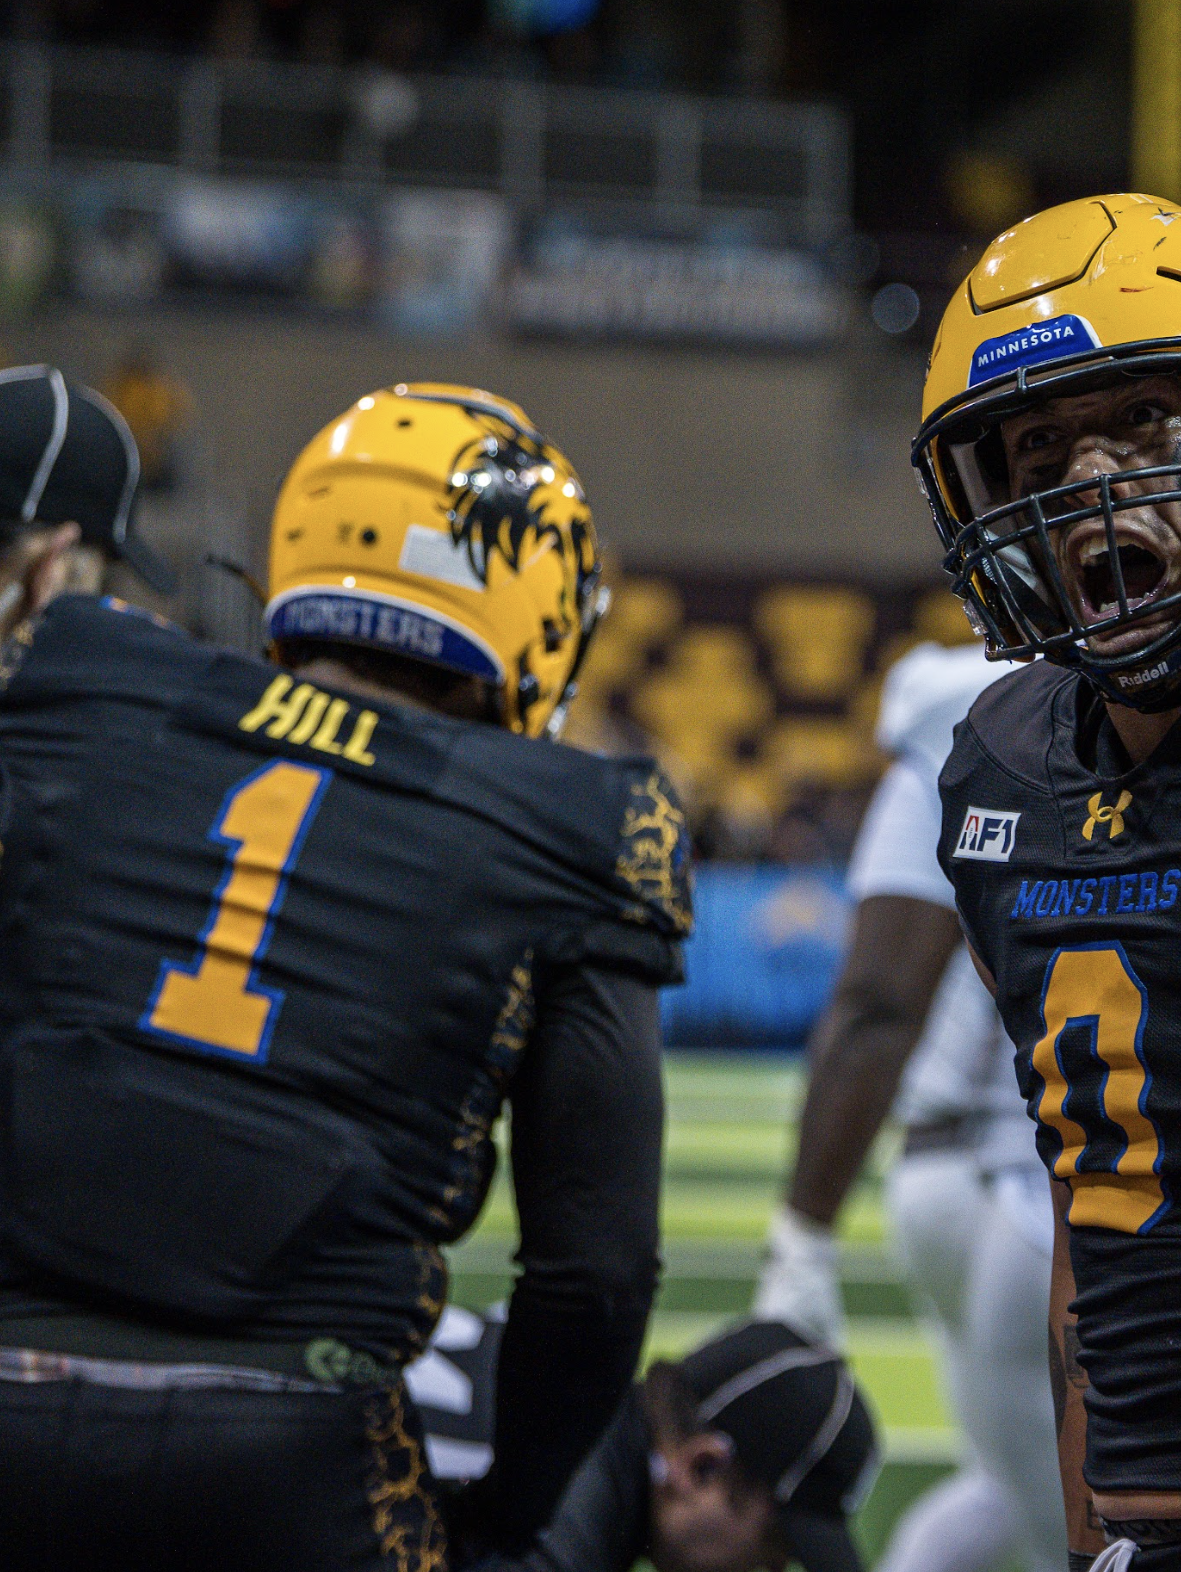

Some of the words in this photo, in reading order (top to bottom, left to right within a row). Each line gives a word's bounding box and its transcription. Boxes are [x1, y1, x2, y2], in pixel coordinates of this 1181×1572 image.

[978, 326, 1075, 368] MINNESOTA
[283, 595, 444, 656] MONSTERS
[1118, 661, 1170, 688] Riddell
[238, 673, 379, 767] HILL
[959, 814, 1015, 854] AF1
[138, 758, 332, 1064] 1
[1010, 868, 1181, 919] MONSTERS
[1028, 940, 1174, 1235] 0
